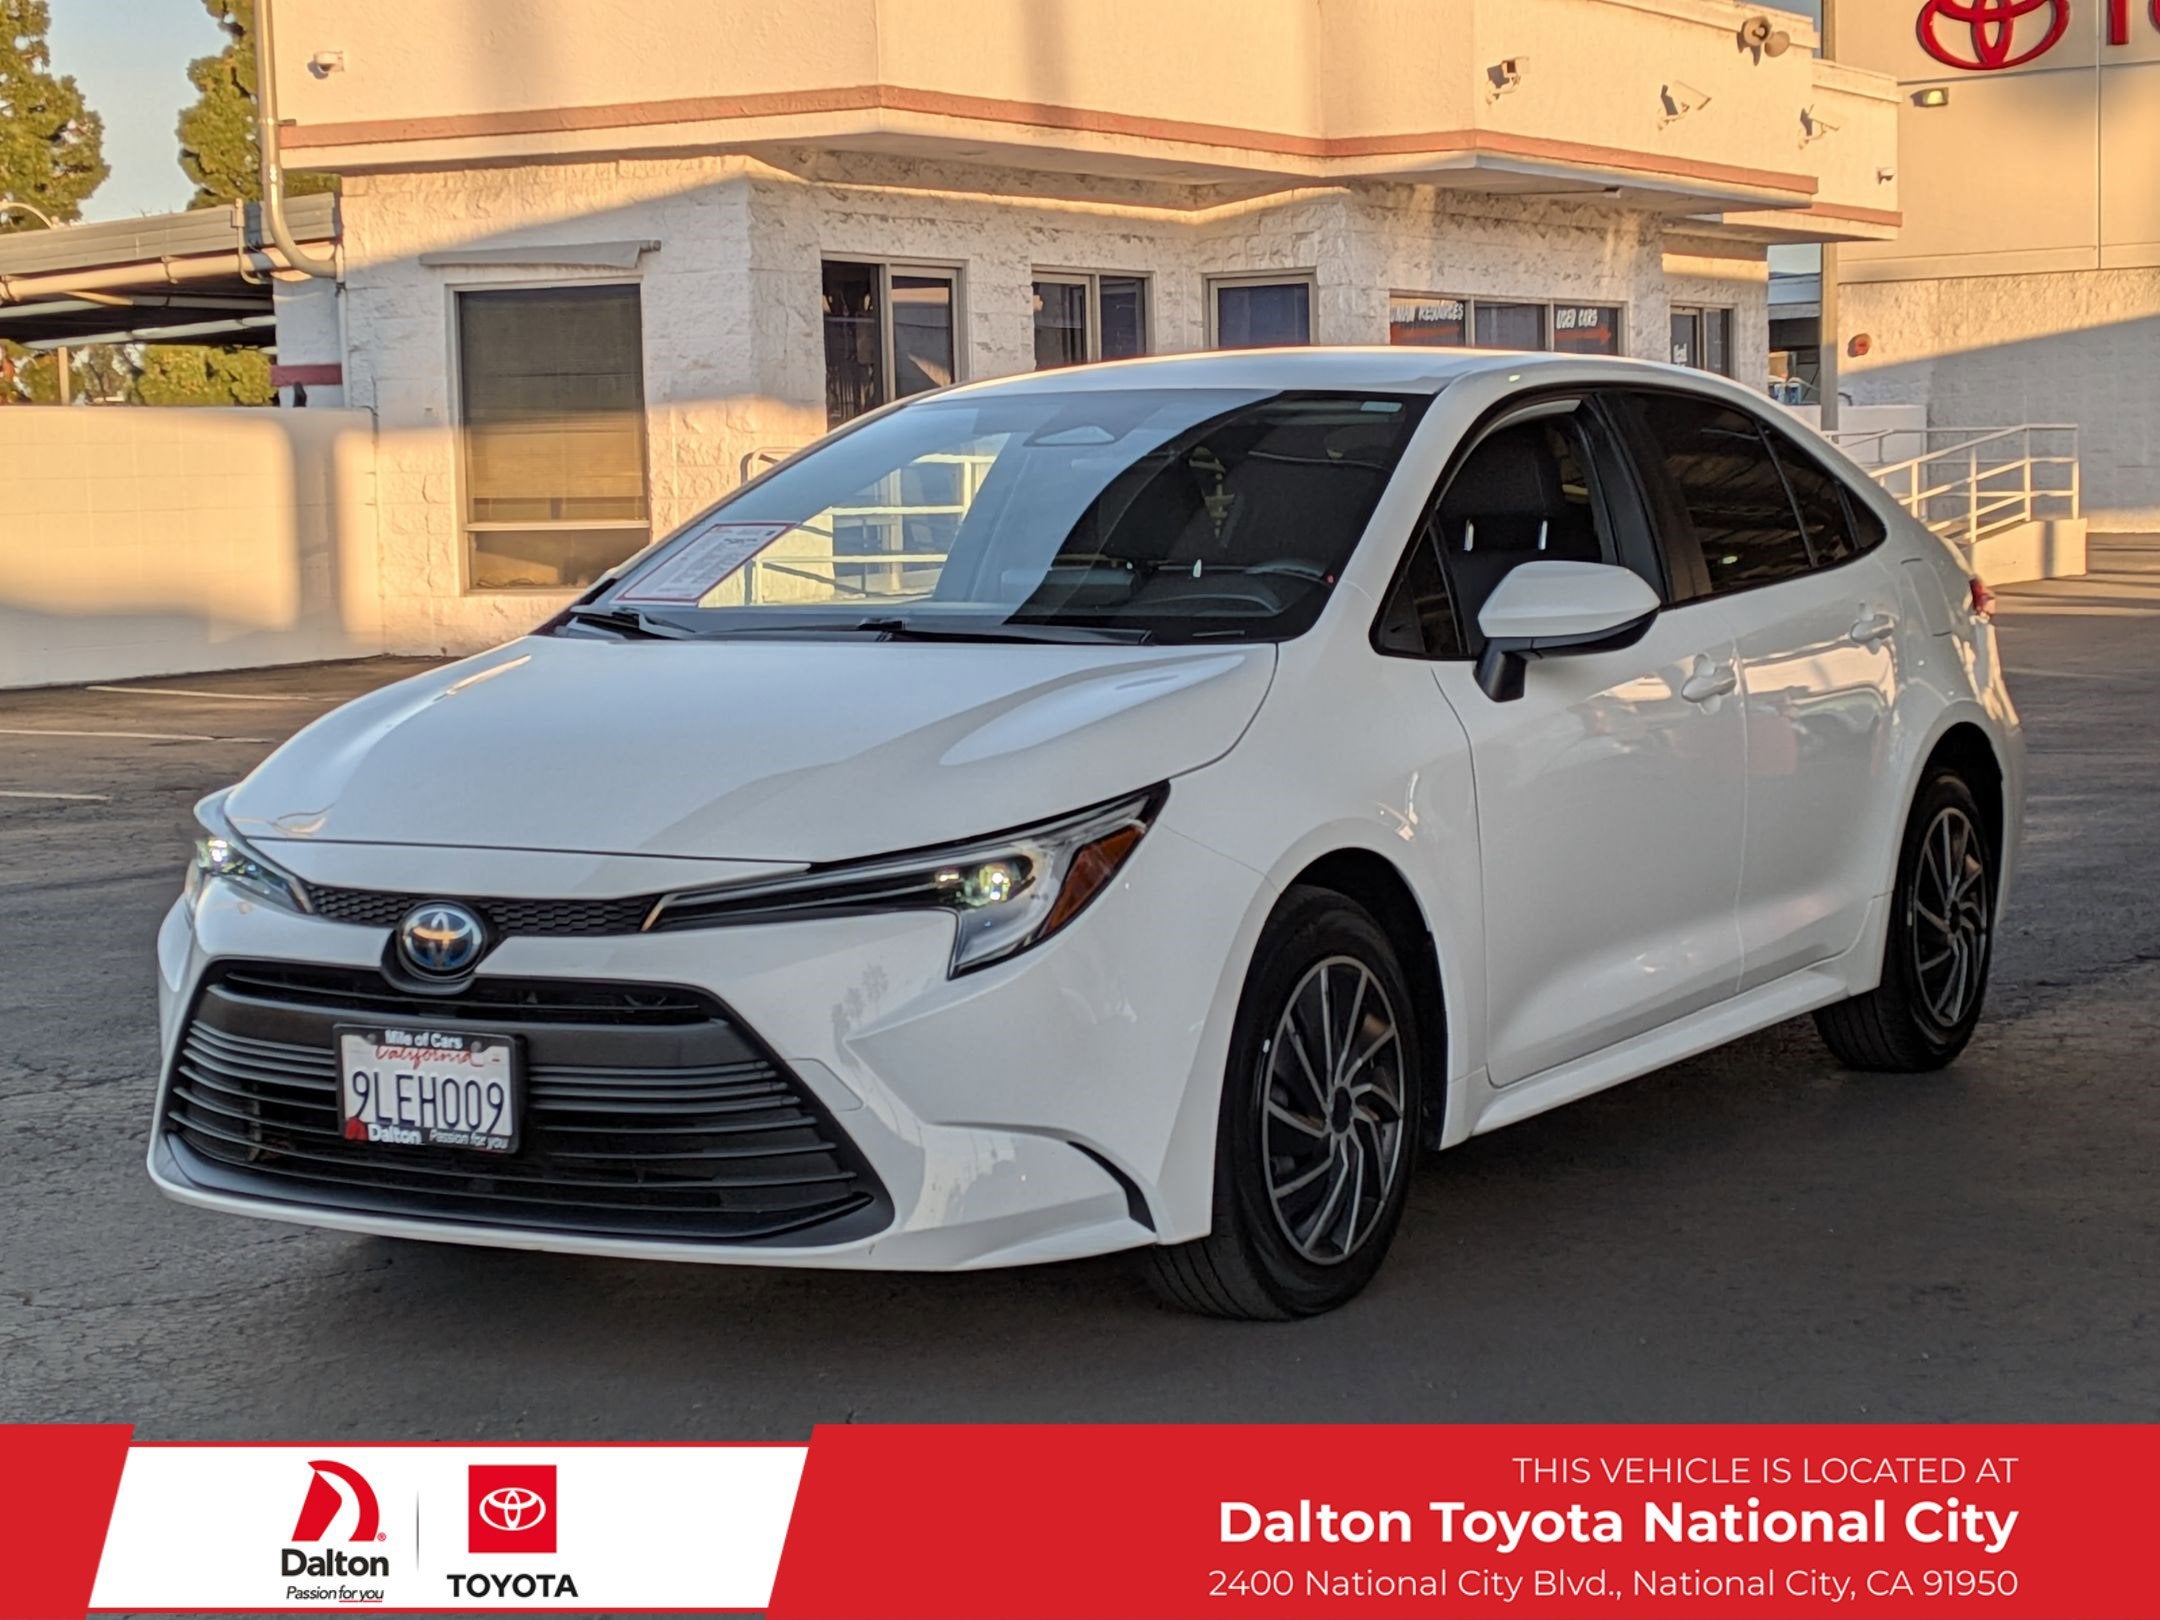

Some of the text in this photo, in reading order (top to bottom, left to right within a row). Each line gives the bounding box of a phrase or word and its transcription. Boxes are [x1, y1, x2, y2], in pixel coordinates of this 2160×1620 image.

[385, 1029, 463, 1050] Mile of Cars
[374, 1045, 484, 1070] California
[352, 1070, 505, 1134] 9LEH009
[367, 1123, 422, 1145] Dalton
[429, 1129, 509, 1150] Passion for you
